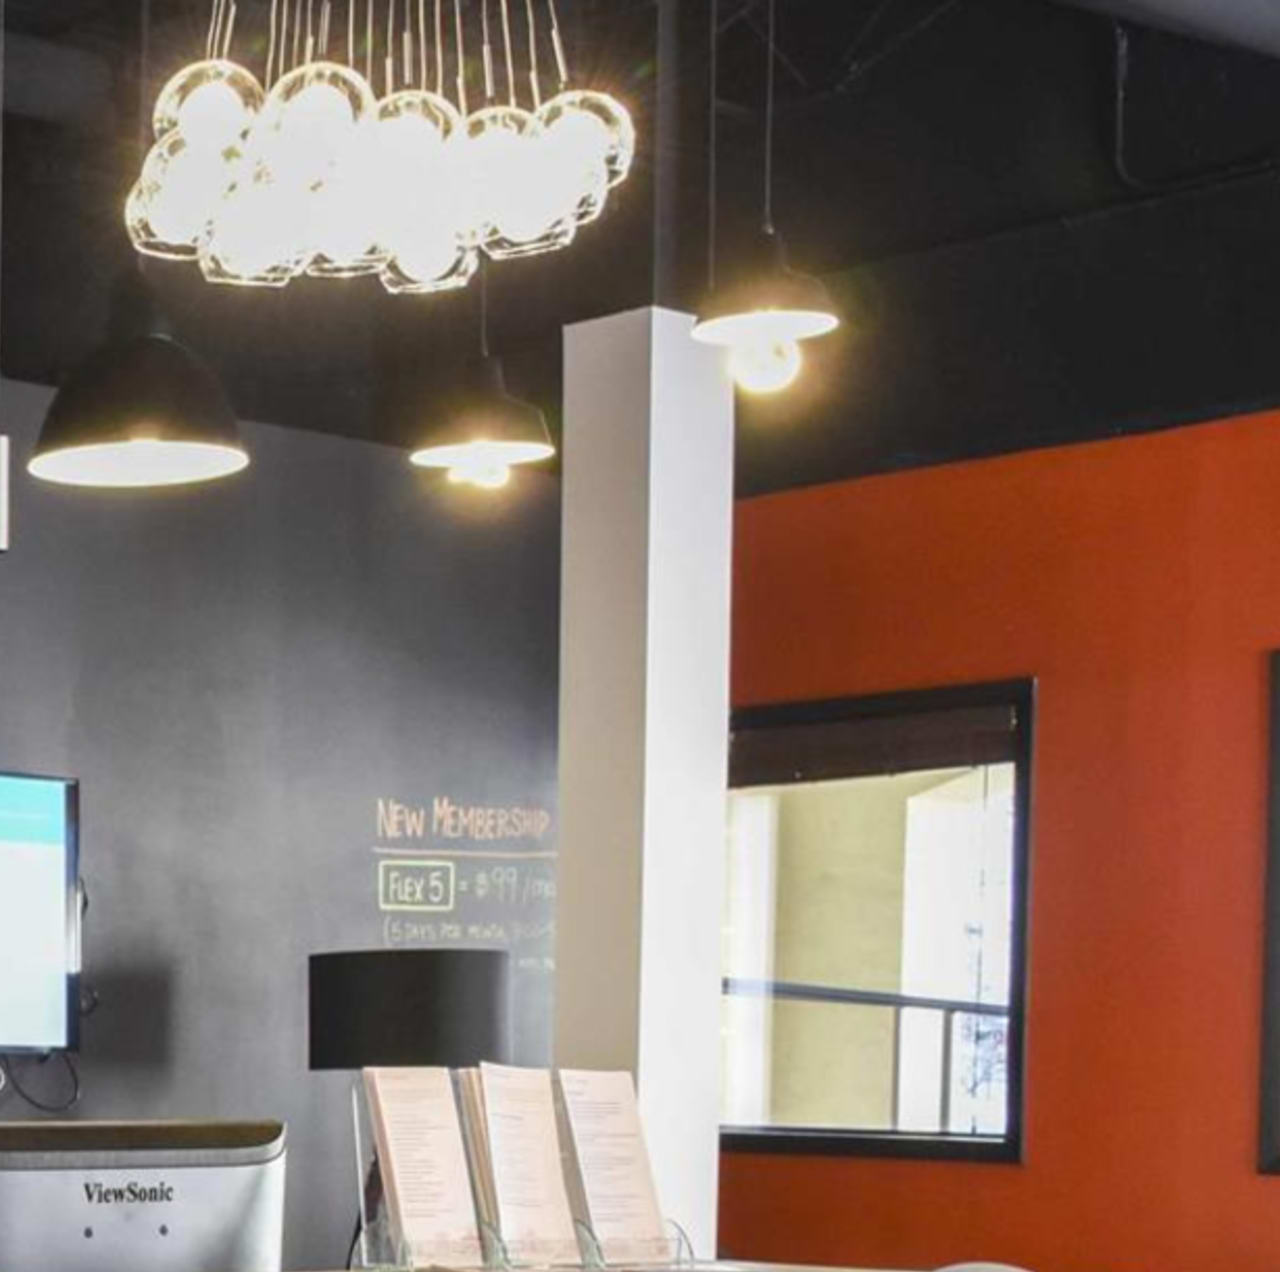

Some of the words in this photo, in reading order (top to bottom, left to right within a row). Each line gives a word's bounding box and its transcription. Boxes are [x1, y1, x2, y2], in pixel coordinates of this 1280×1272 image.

[377, 798, 425, 837] NEW
[432, 797, 550, 840] MEMBERSHIP
[389, 870, 424, 902] FLEX
[429, 871, 444, 903] 5
[84, 1181, 173, 1203] ViewSonic
